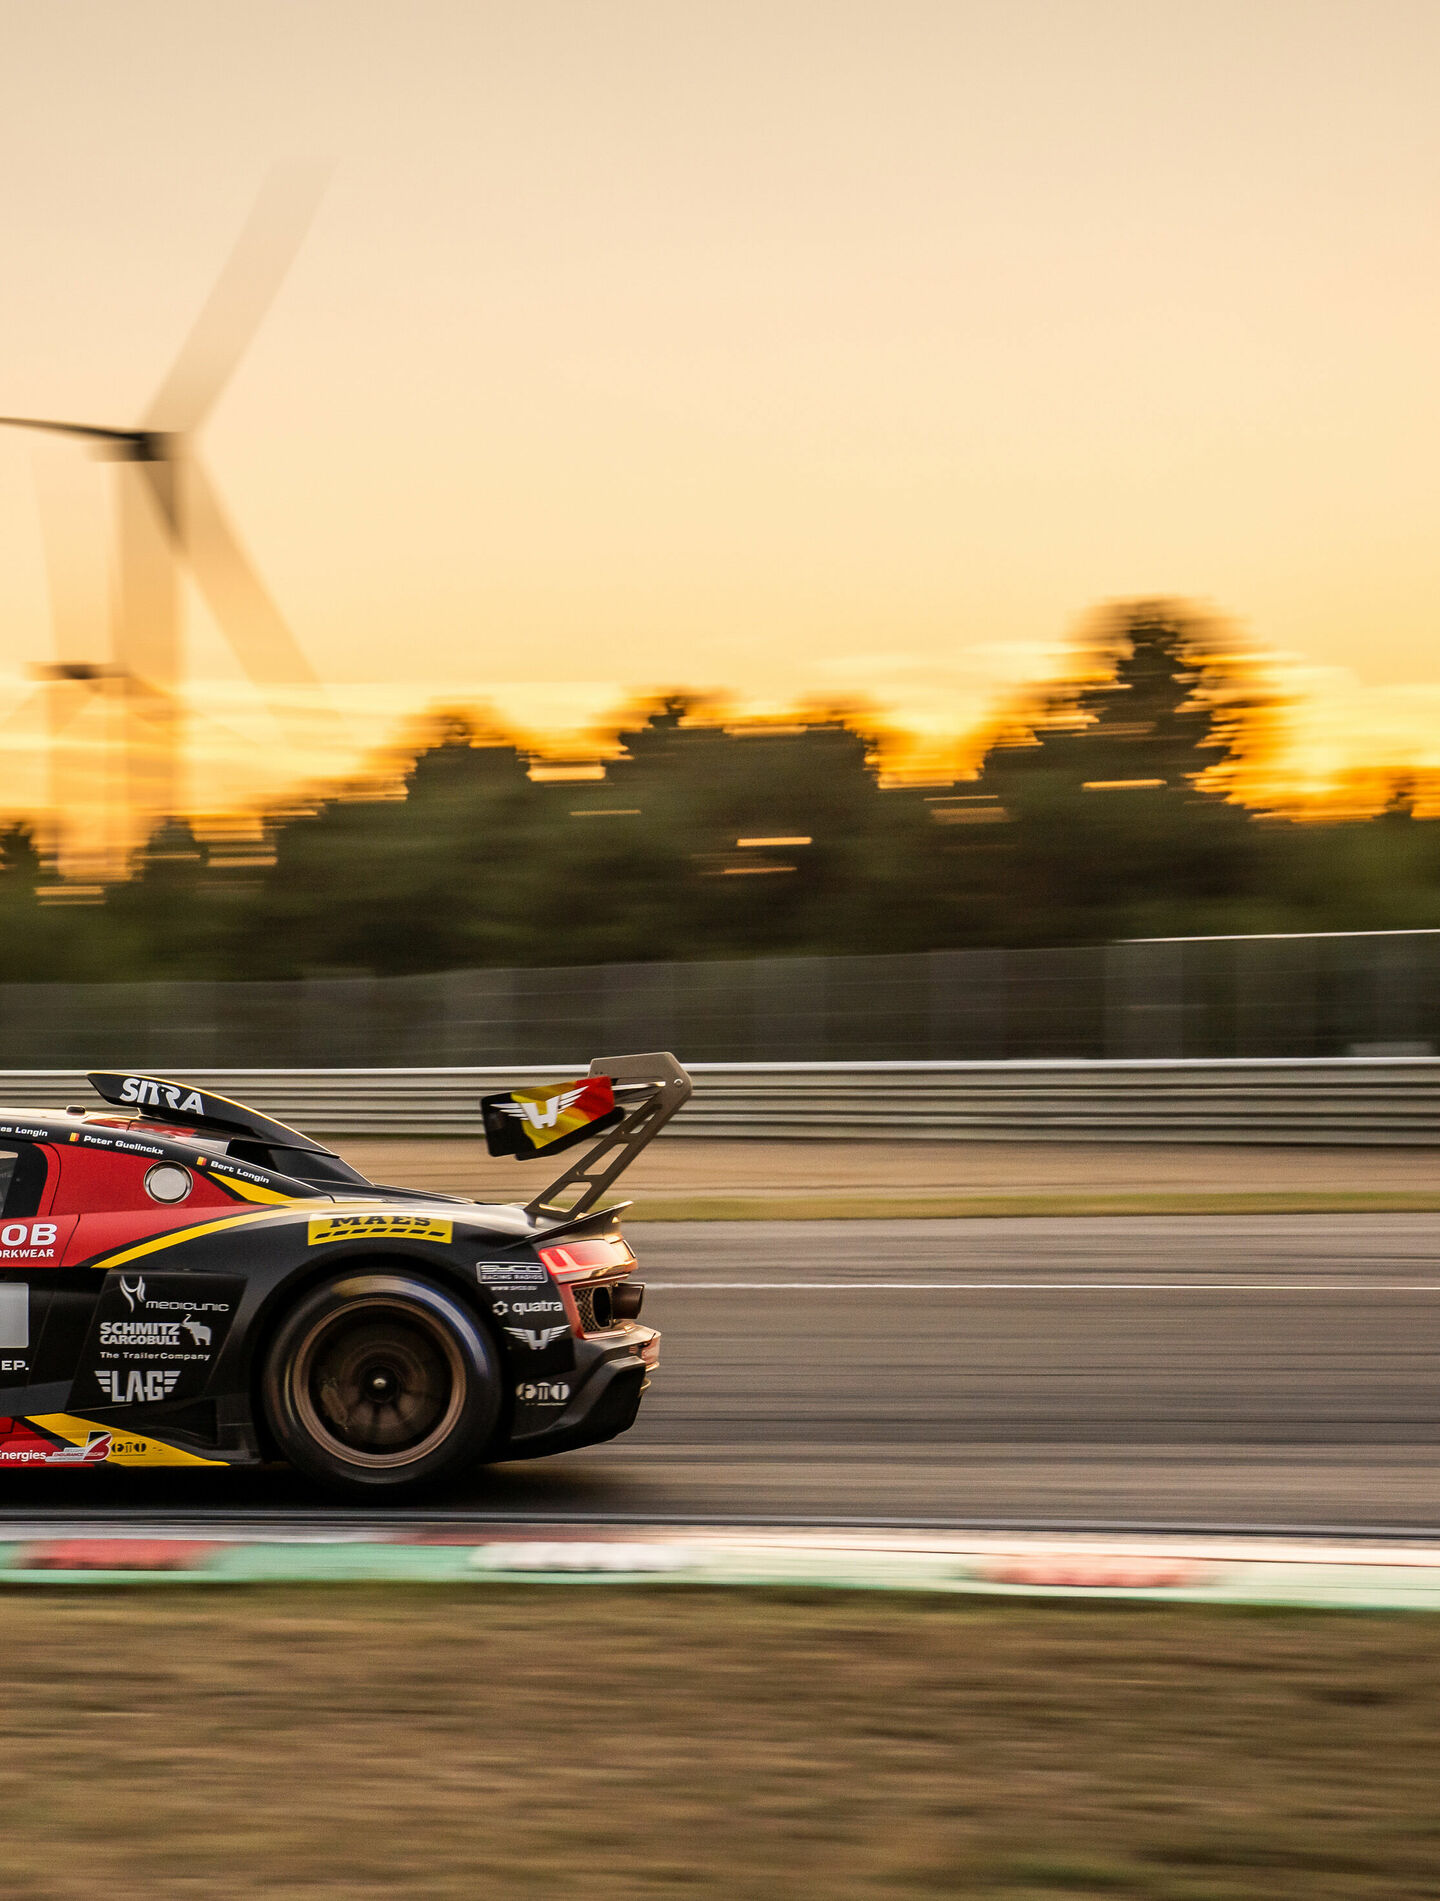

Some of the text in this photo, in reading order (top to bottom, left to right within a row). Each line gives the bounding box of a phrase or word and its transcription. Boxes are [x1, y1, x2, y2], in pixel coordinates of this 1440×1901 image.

[119, 1078, 205, 1115] SITRA
[15, 1126, 49, 1138] Longin
[83, 1134, 164, 1155] Peter Guelinckx
[210, 1160, 270, 1184] Bert Longin
[512, 1300, 564, 1315] quatra
[100, 1322, 180, 1335] SCHMITZ
[100, 1335, 180, 1345] CARGOBULL
[100, 1351, 211, 1361] The Trailer Company
[111, 1370, 164, 1402] LAG
